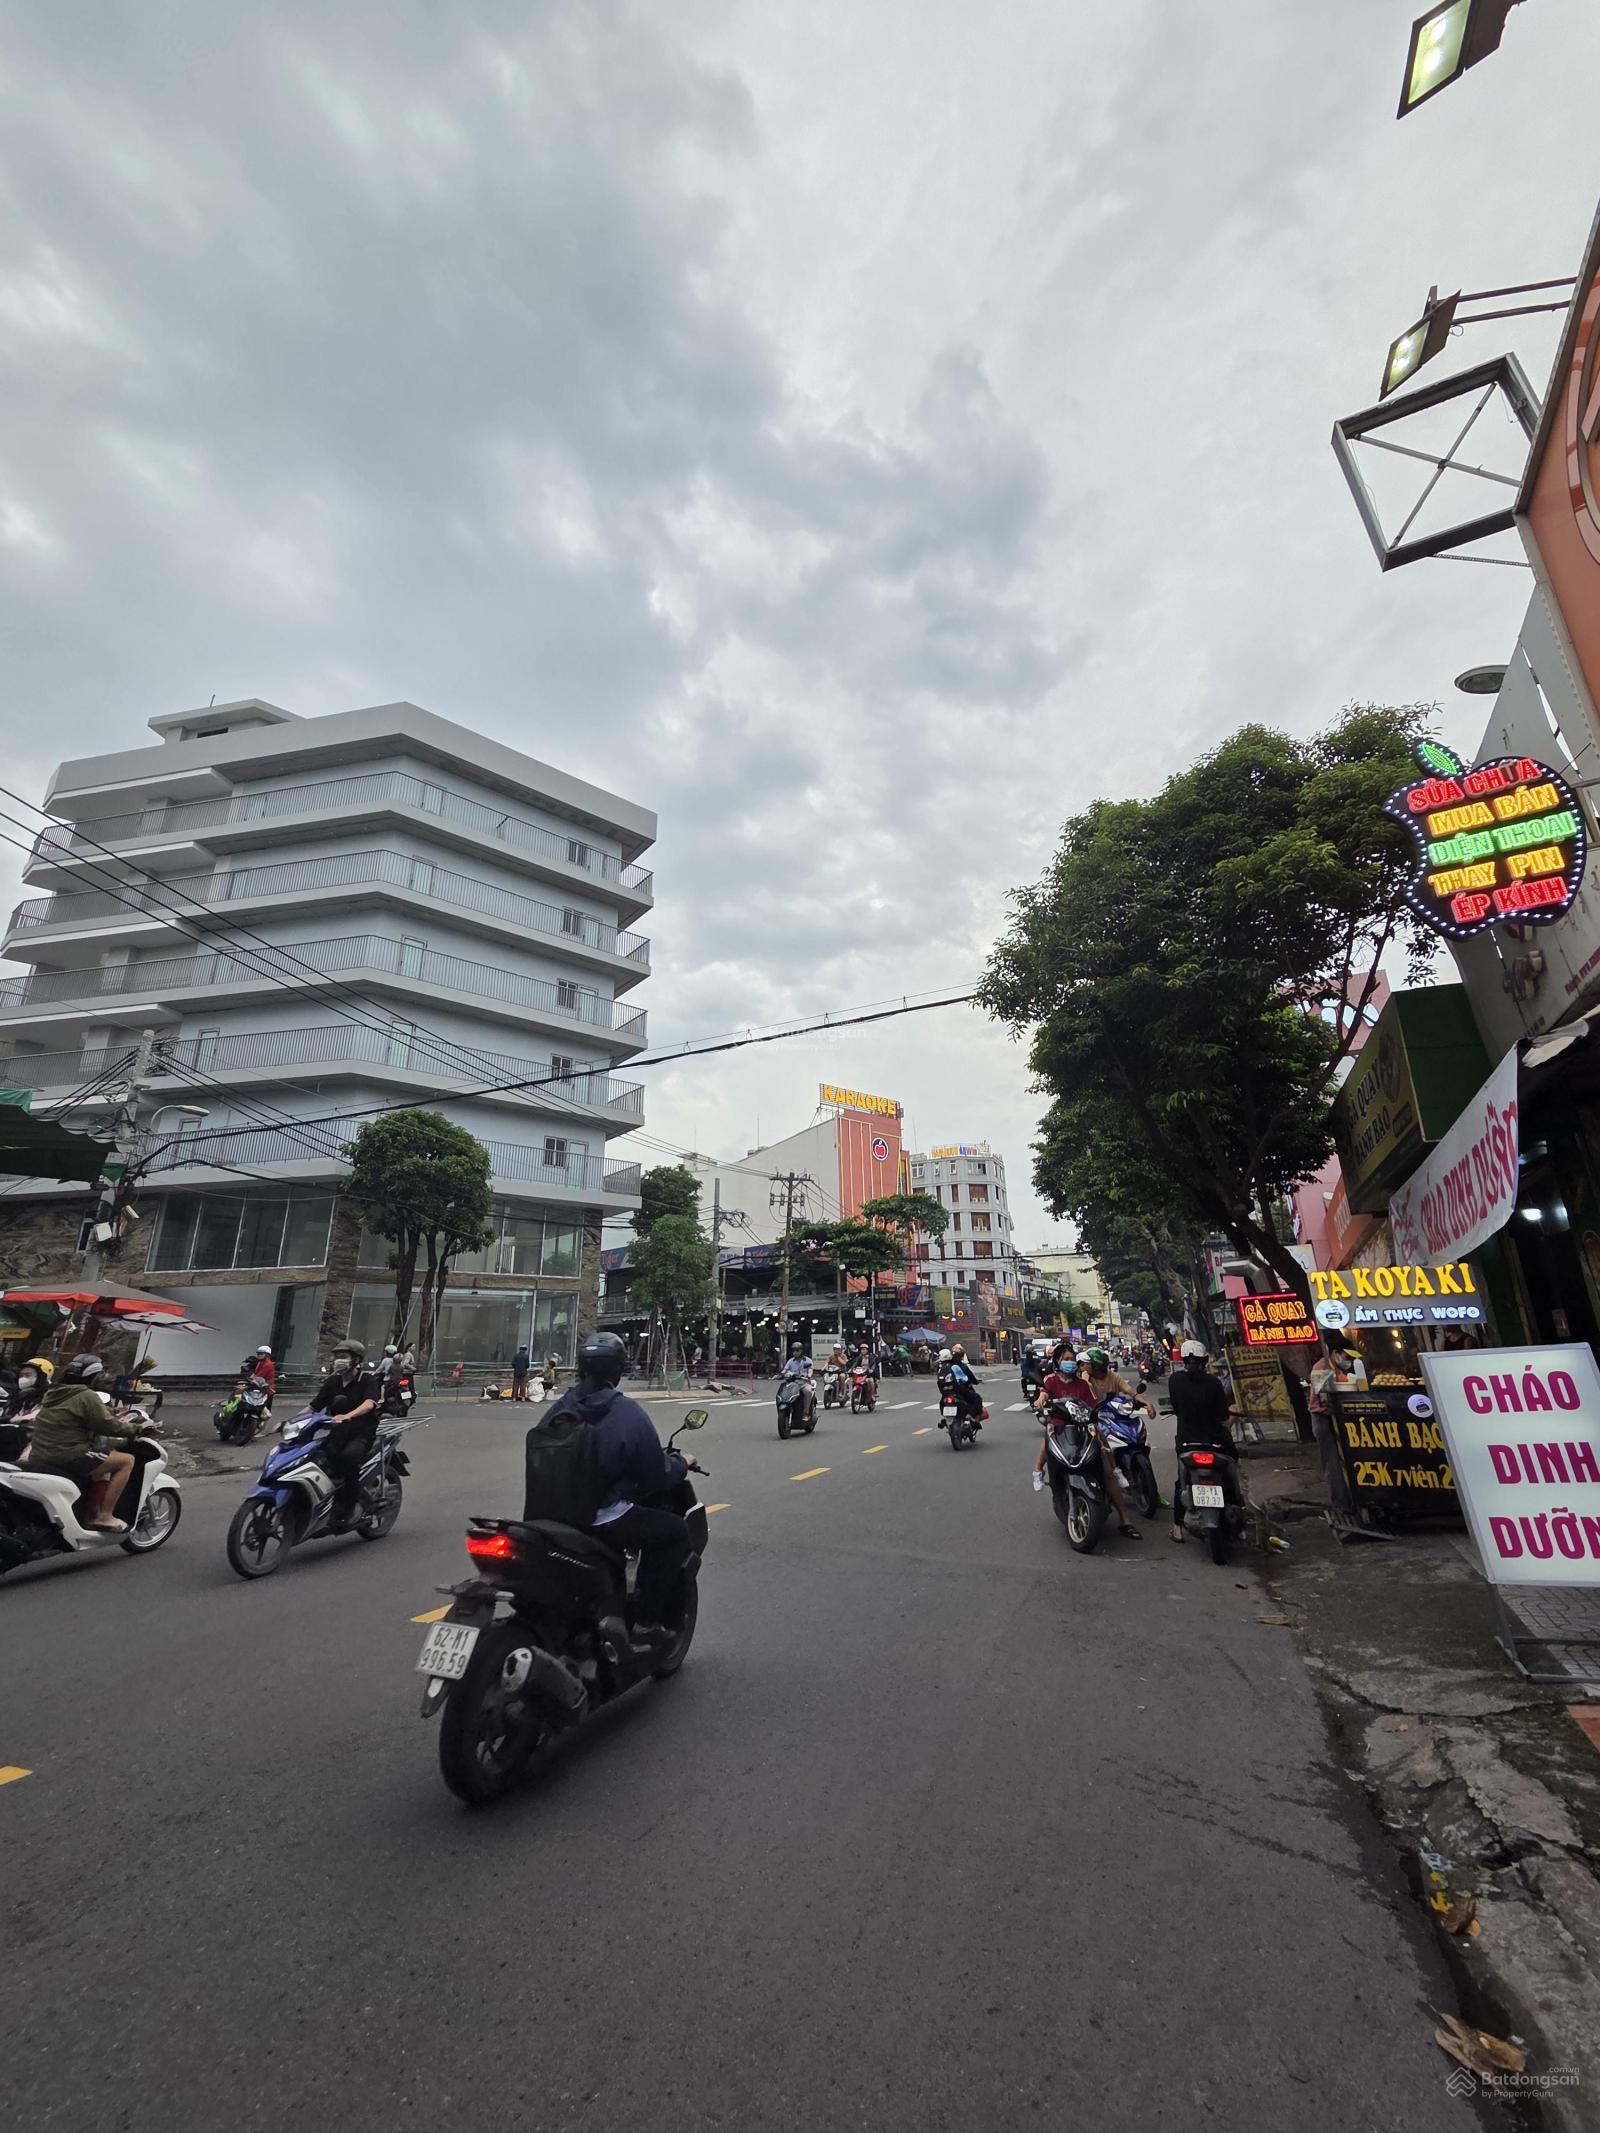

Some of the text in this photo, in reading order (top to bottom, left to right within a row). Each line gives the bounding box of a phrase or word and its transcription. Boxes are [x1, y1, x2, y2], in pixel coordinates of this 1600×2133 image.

[1428, 783, 1559, 838] MUA BÁN
[1492, 811, 1577, 850] THOẠI
[1428, 846, 1565, 898] THAY PIN
[1451, 876, 1568, 923] ÉP KÍNH
[822, 1083, 896, 1115] KARAOKE
[1244, 1300, 1267, 1322] GÀ
[1267, 1301, 1307, 1324] QUAY
[1383, 1307, 1424, 1324] THỰC
[1431, 1306, 1480, 1320] WOFO
[1249, 1325, 1313, 1341] BÁNH BAO
[1462, 1364, 1581, 1414] CHÁO
[1345, 1417, 1402, 1448] BÁNH
[1353, 1461, 1393, 1487] 25K
[1487, 1441, 1600, 1485] DINH
[421, 1648, 466, 1675] 996.59
